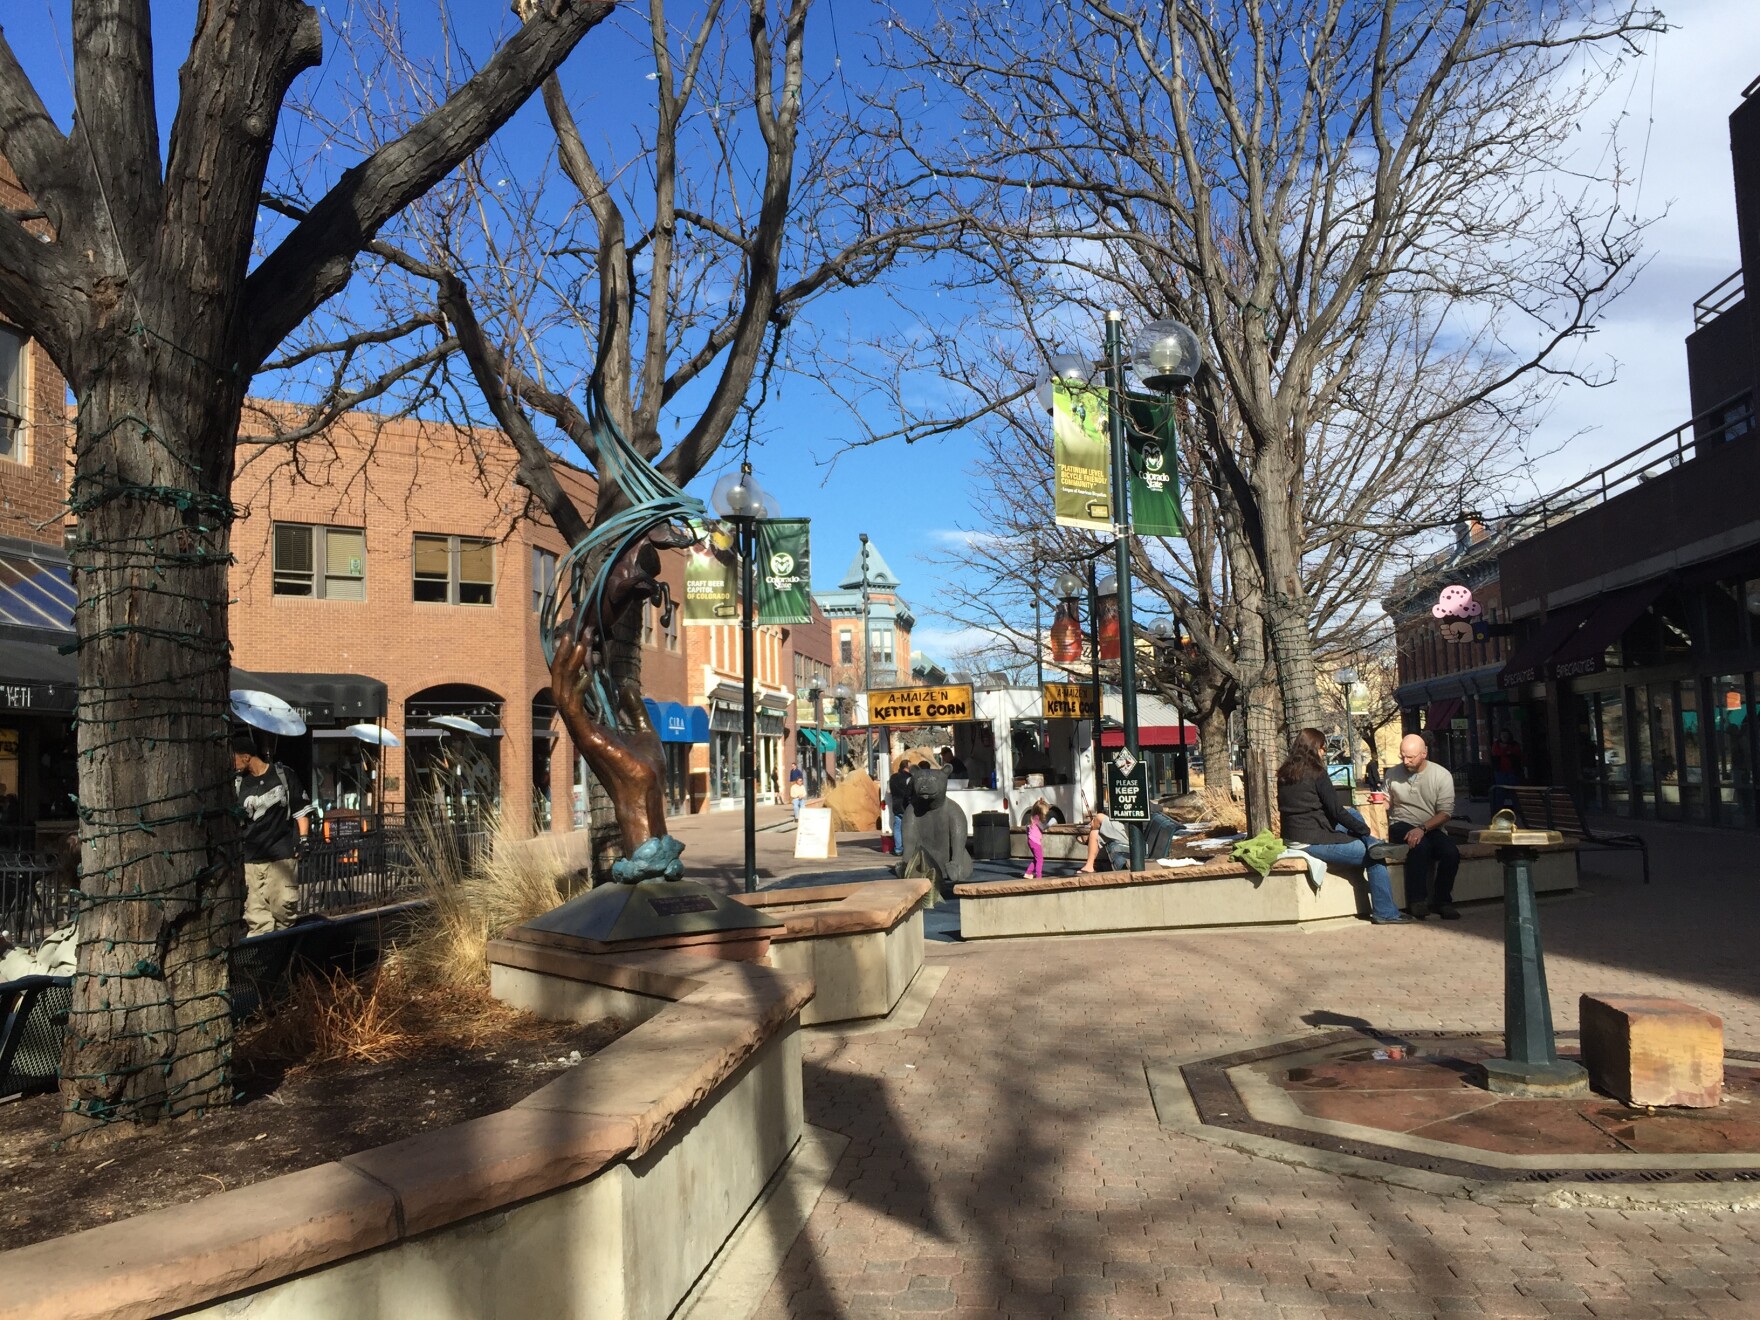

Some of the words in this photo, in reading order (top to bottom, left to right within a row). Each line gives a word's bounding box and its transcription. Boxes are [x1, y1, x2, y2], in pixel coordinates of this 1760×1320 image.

[1061, 471, 1082, 480] BICYCLE
[1084, 475, 1107, 484] FRIENDLY
[1089, 469, 1104, 477] LEVEL
[1139, 471, 1169, 481] Colorado
[766, 576, 800, 584] Colorado
[6, 686, 31, 707] YETI
[874, 703, 922, 720] KETTLE
[927, 702, 966, 717] CORN
[1047, 700, 1076, 715] KETTLE
[1115, 787, 1139, 795] KEEP
[1118, 795, 1137, 803] OUT
